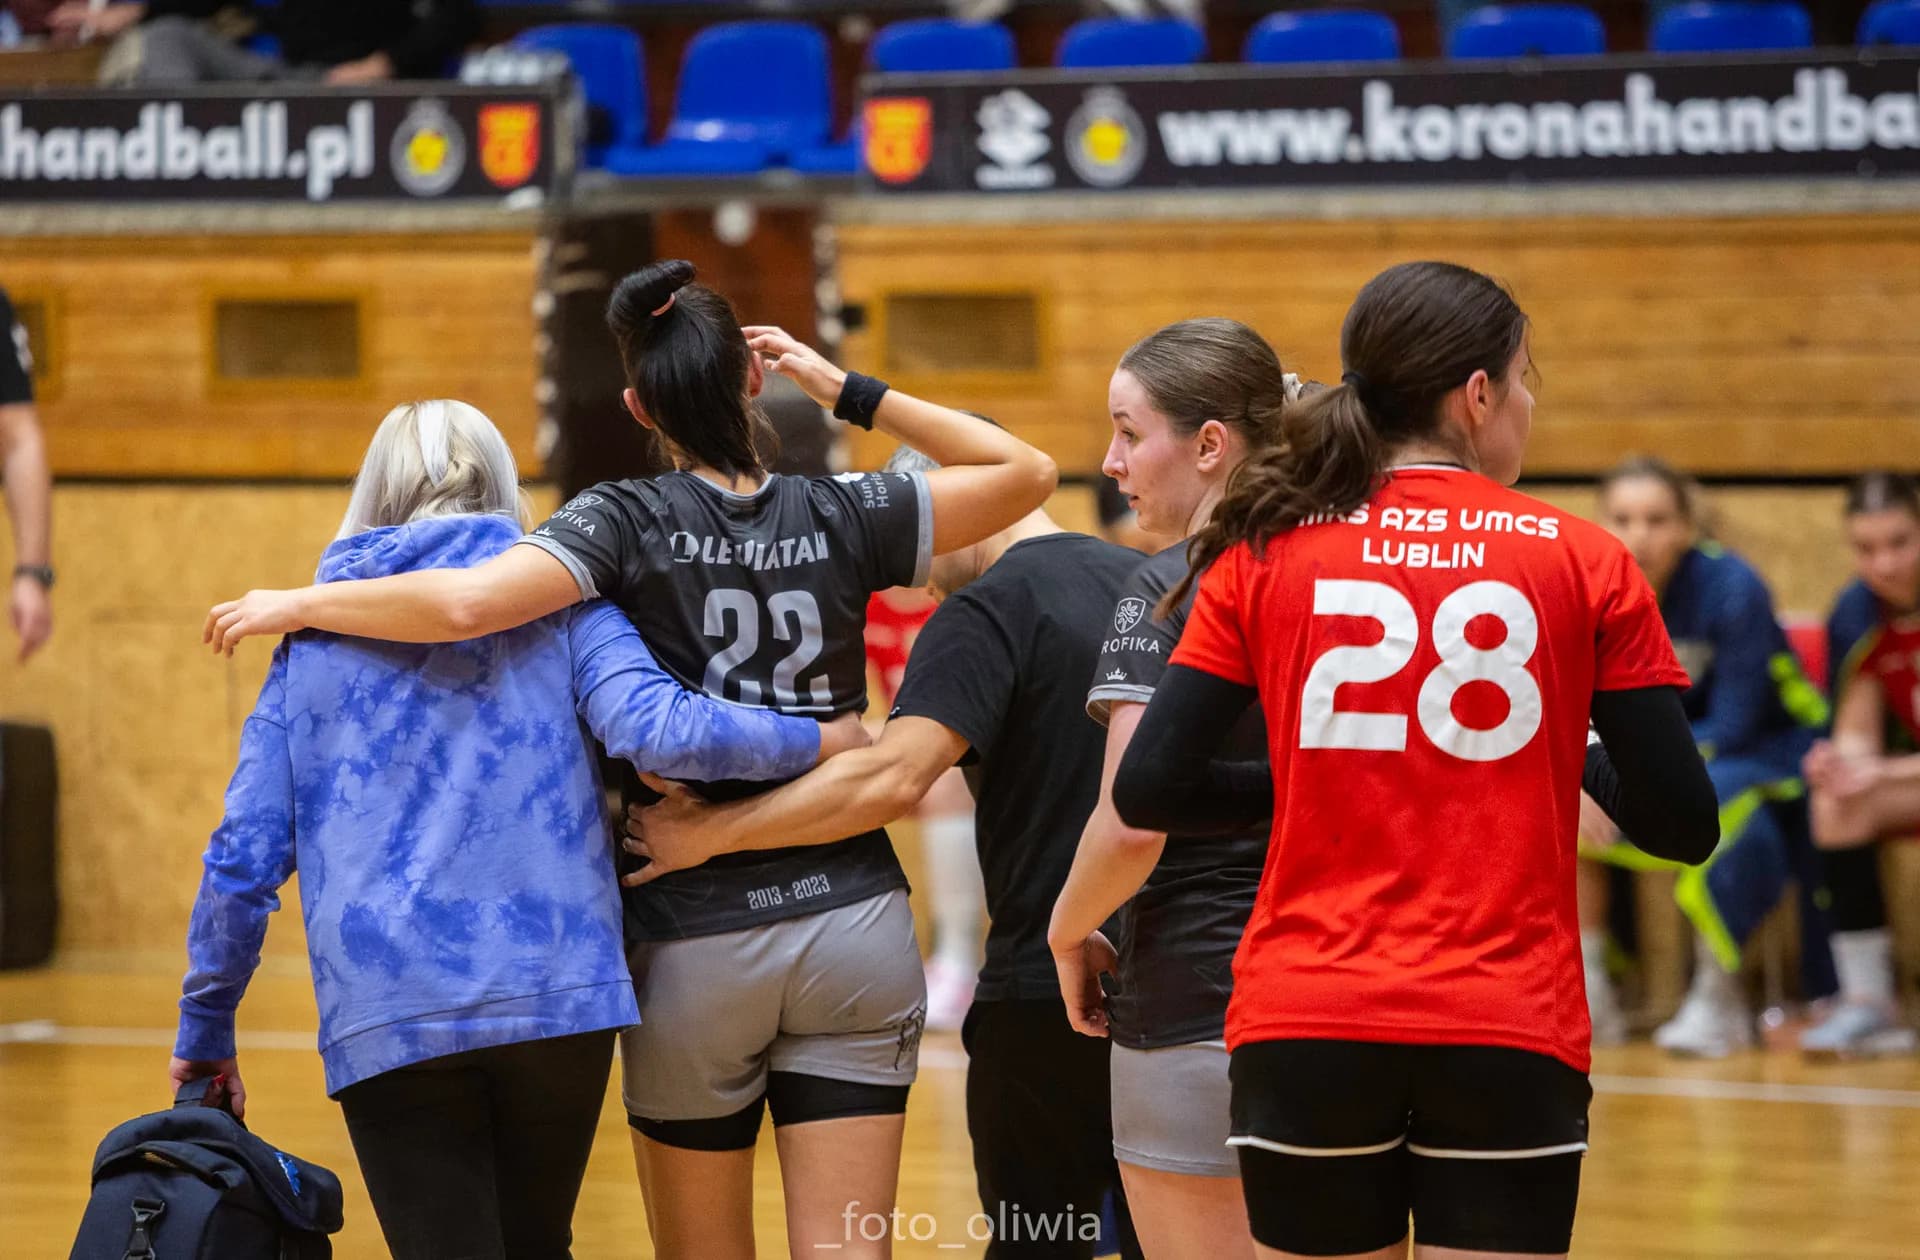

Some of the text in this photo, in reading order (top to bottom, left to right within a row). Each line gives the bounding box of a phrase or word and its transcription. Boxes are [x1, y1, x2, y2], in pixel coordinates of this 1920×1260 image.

[1156, 66, 1920, 167] www.koronahandba
[0, 102, 374, 200] handball.pl
[861, 481, 876, 509] Sun
[1380, 507, 1448, 532] AZS
[1459, 508, 1559, 539] UMCS
[1362, 537, 1485, 568] LUBLIN
[702, 589, 834, 712] 22
[1300, 579, 1542, 762] 28
[747, 886, 783, 910] 2013
[792, 873, 831, 899] 2023
